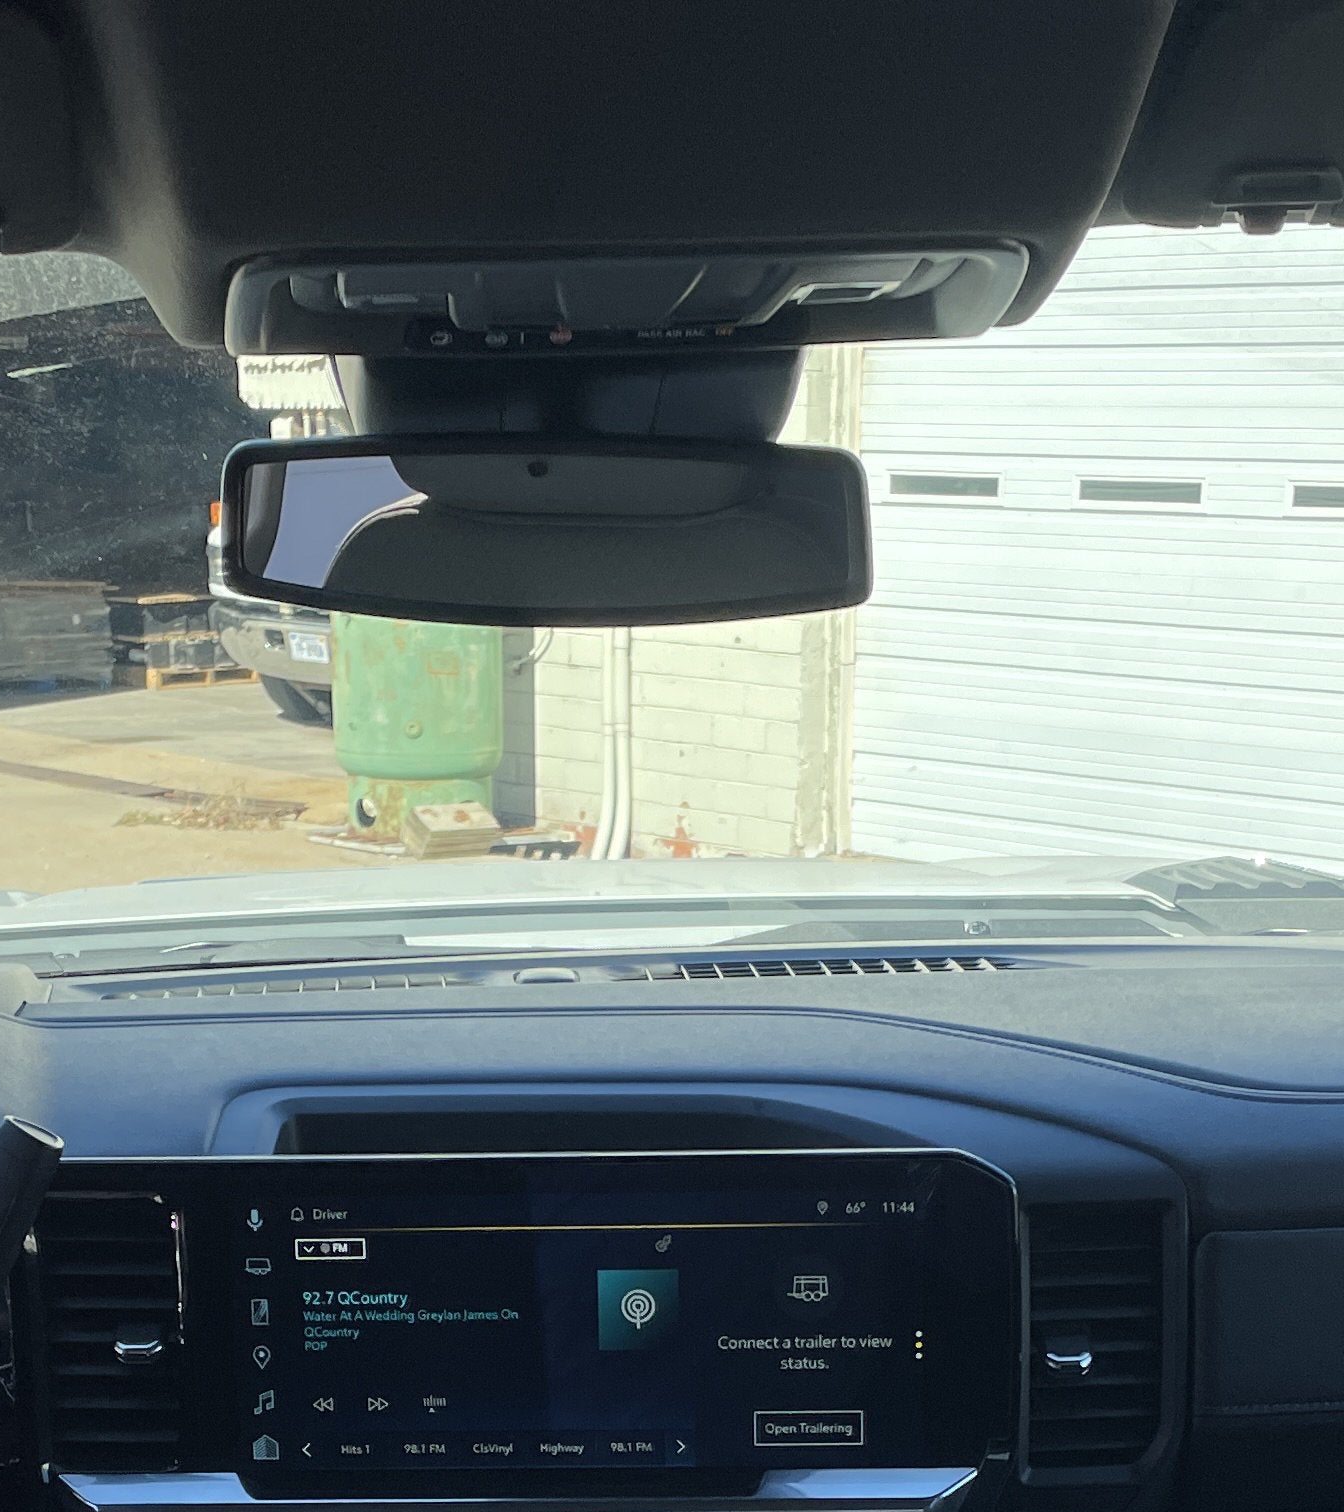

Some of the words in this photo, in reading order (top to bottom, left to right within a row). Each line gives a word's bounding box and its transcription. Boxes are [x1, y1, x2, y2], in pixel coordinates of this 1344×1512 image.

[845, 1201, 867, 1214] 66°
[882, 1201, 916, 1213] 11:44
[312, 1208, 348, 1220] Driver
[332, 1243, 348, 1253] FM
[302, 1290, 335, 1305] 92.7
[337, 1290, 408, 1308] QCountry
[303, 1310, 336, 1322] Water
[340, 1310, 353, 1322] At
[353, 1310, 364, 1322] A
[365, 1309, 416, 1324] Wedding
[417, 1308, 461, 1324] Greylan
[462, 1308, 499, 1321] James
[501, 1308, 519, 1320] On
[304, 1326, 360, 1341] QCountry
[304, 1341, 328, 1351] POP
[717, 1335, 780, 1350] Connect
[781, 1338, 791, 1349] a
[794, 1334, 837, 1349] trailer
[841, 1336, 856, 1349] to
[858, 1334, 894, 1349] view
[780, 1356, 830, 1370] status.
[764, 1422, 798, 1436] Open
[799, 1422, 854, 1436] Trailering
[341, 1444, 362, 1455] Hits
[404, 1443, 426, 1454] 98.1
[429, 1443, 446, 1454] FM
[540, 1442, 584, 1456] Highway
[610, 1442, 633, 1452] 98.1
[635, 1441, 653, 1452] FM
